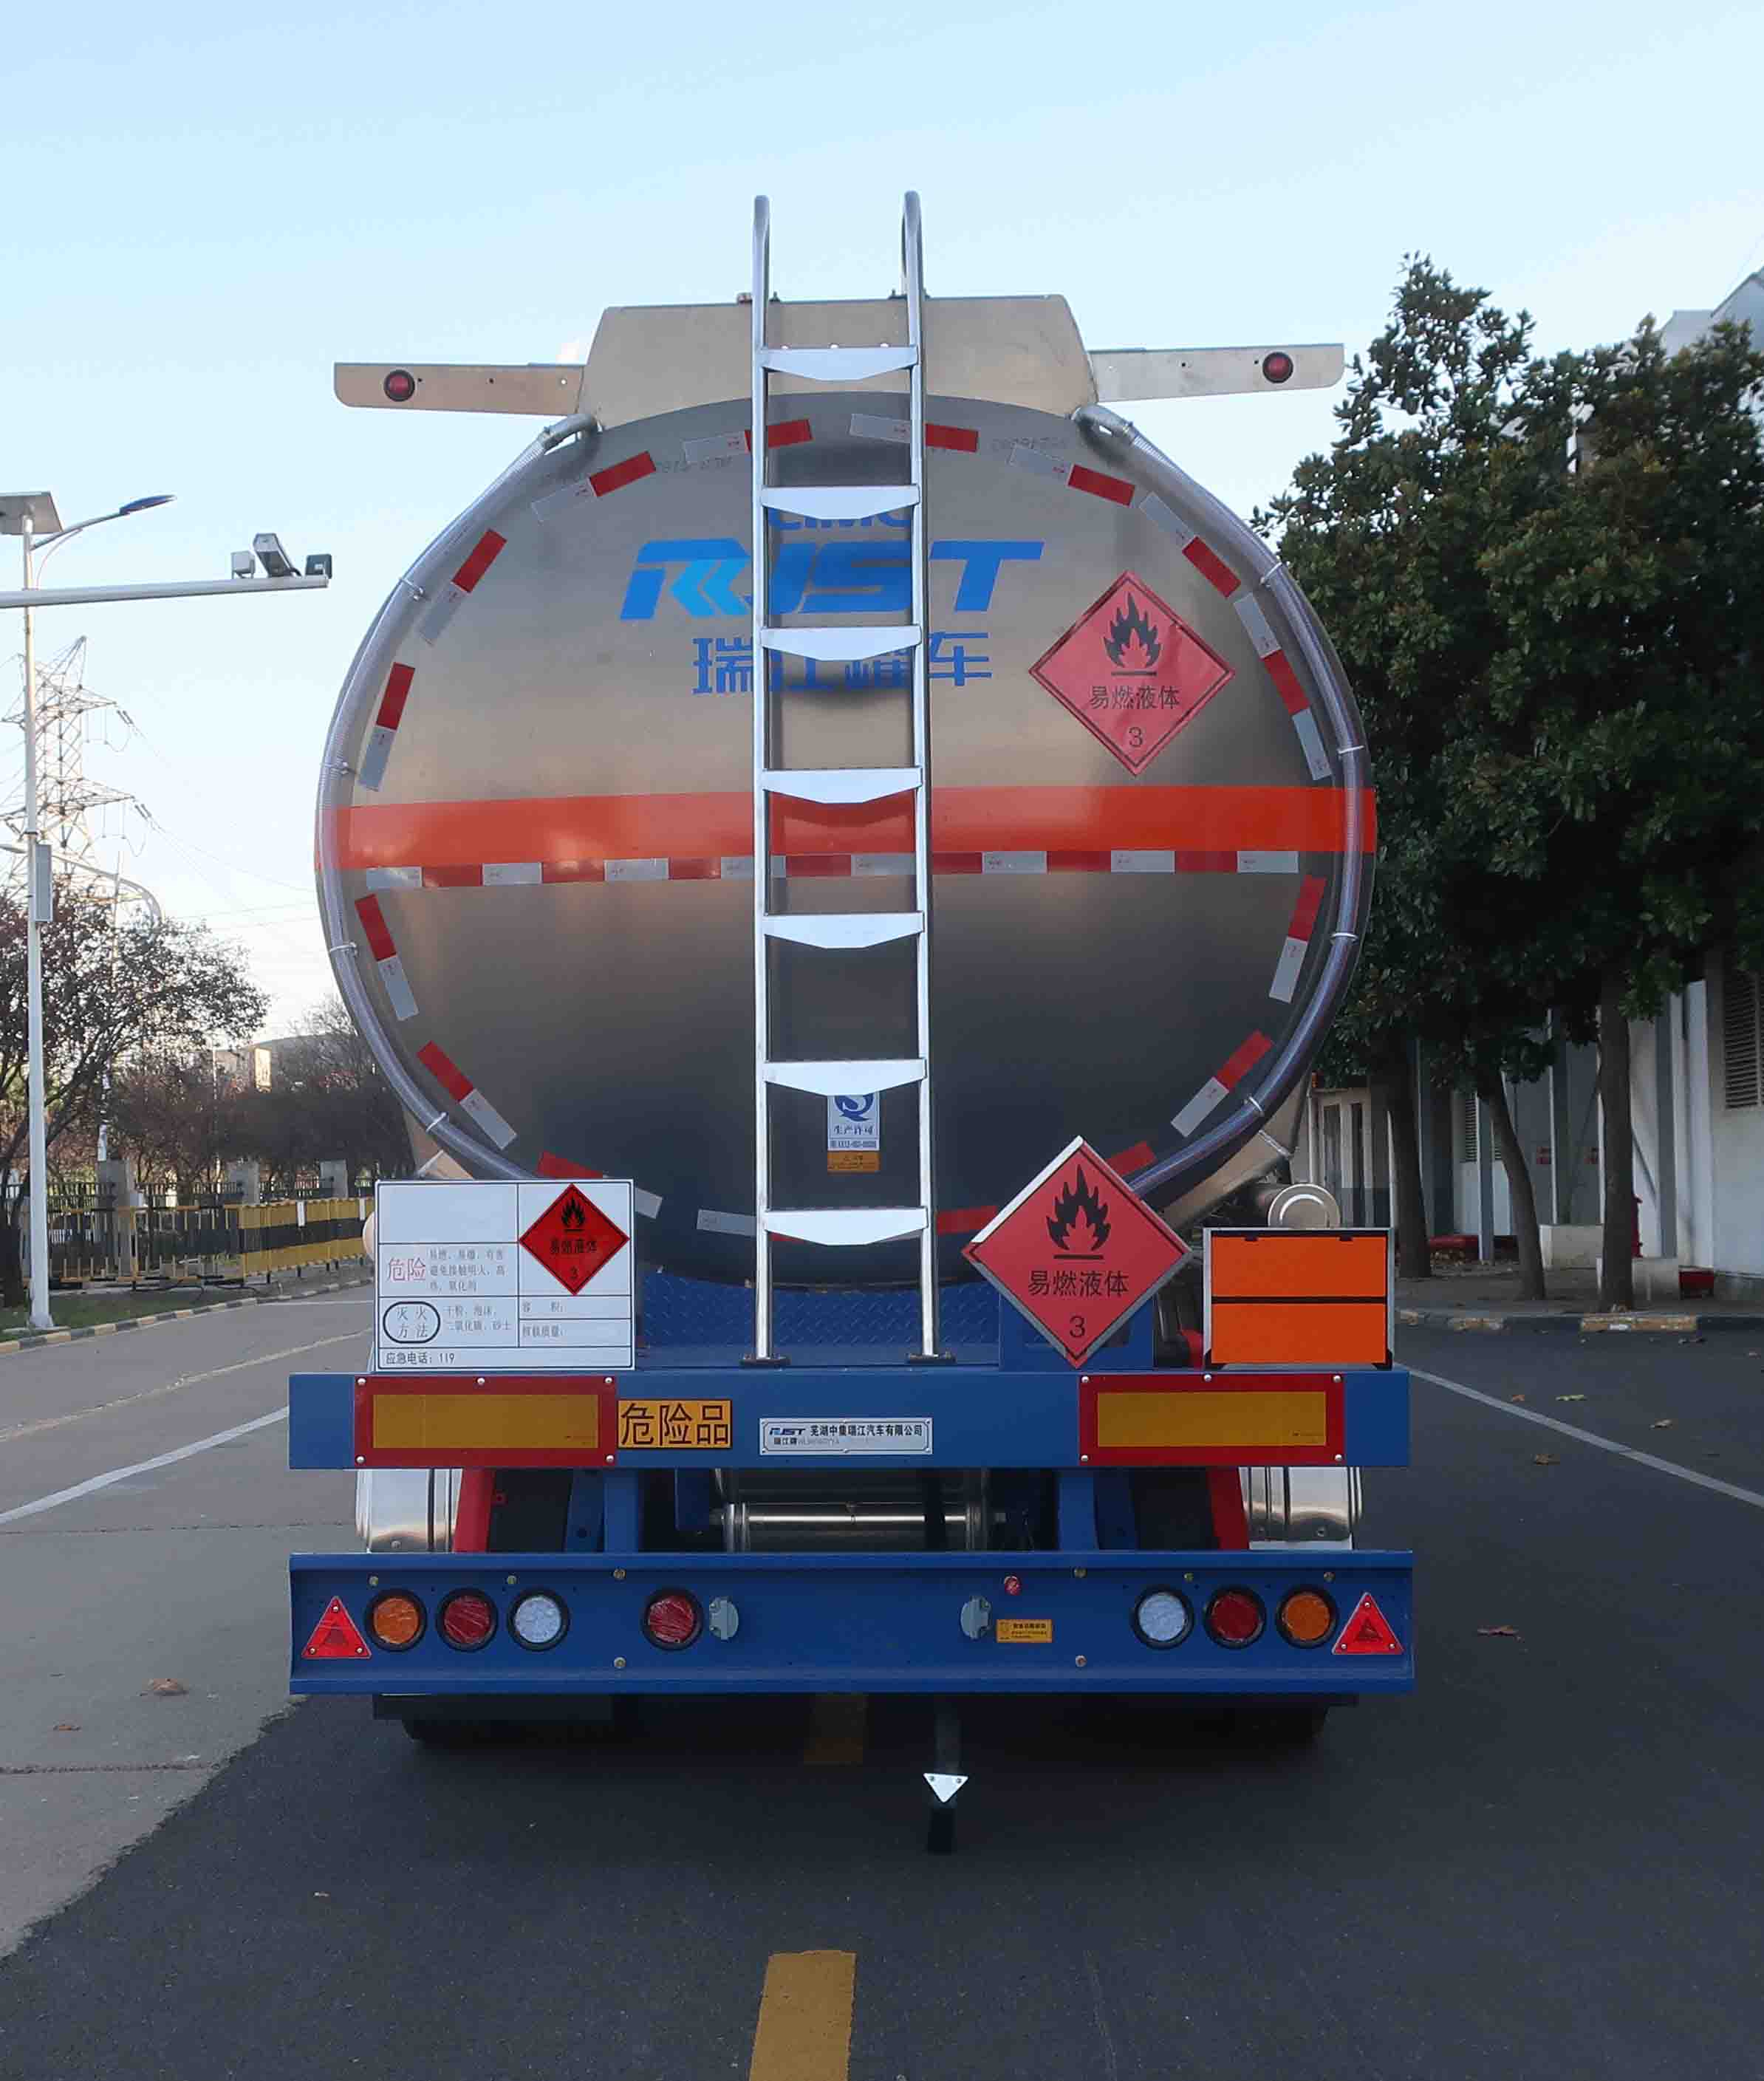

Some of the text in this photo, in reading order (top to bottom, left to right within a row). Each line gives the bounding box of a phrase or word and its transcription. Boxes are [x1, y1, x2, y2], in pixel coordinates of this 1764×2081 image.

[1089, 686, 1180, 710] 易燃液体
[1127, 726, 1143, 748] 3
[387, 1257, 426, 1282] 危险
[1028, 1269, 1129, 1297] 易燃液体
[1069, 1315, 1086, 1339] 3
[621, 1403, 728, 1446] 危险品
[810, 1424, 923, 1437] 芜湖中集瑞江汽车有限公司
